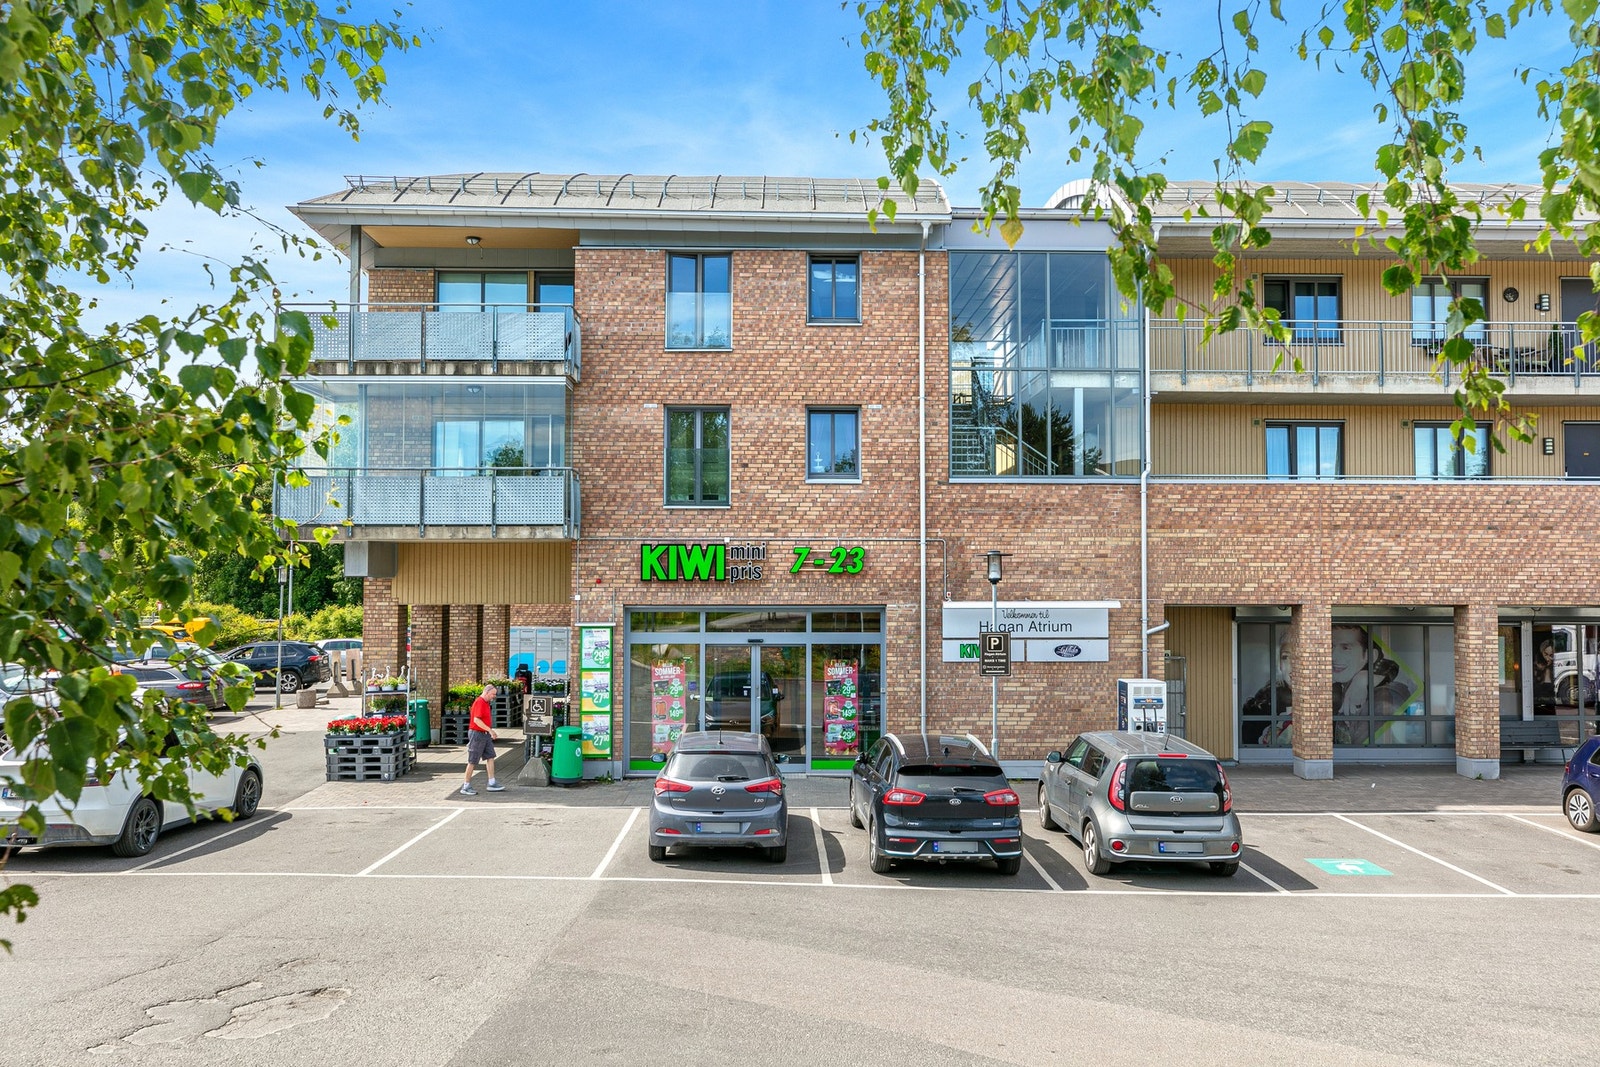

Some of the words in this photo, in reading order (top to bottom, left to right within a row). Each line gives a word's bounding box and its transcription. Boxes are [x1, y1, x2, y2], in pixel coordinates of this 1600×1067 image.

[730, 542, 766, 560] mini
[641, 543, 727, 581] KIWI
[789, 547, 811, 574] 7
[827, 546, 865, 574] 23
[730, 561, 762, 584] pris
[1038, 609, 1050, 619] til
[1028, 620, 1073, 633] Atrium
[960, 644, 980, 658] KI
[990, 637, 1000, 650] P
